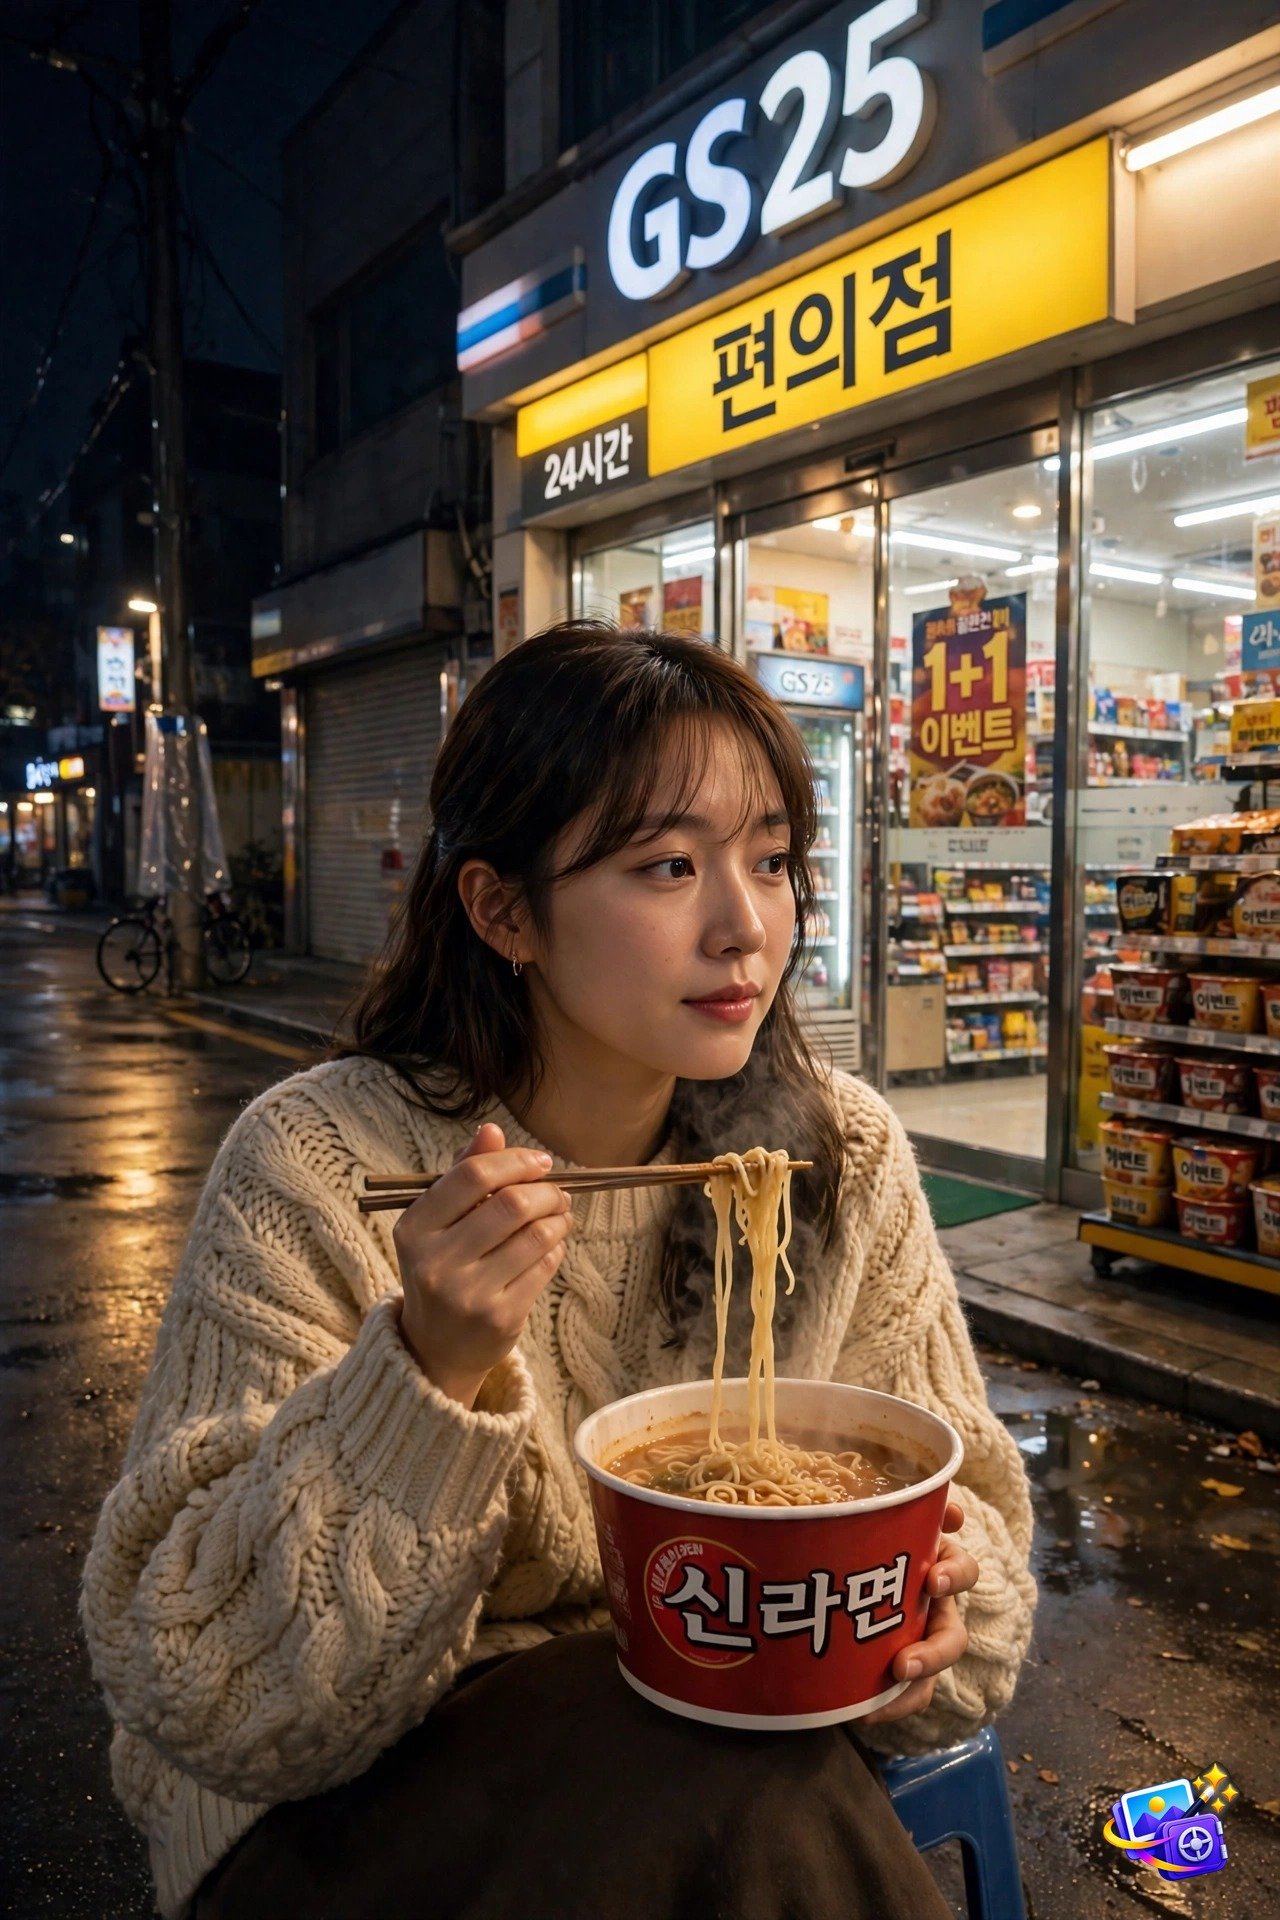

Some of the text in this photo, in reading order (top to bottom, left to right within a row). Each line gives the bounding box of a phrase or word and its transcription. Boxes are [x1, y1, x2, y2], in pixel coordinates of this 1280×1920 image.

[607, 0, 926, 300] GS25
[712, 229, 952, 432] 편의점
[543, 422, 633, 499] 24시간
[780, 670, 834, 696] GS25
[923, 631, 1009, 711] 1+1
[921, 707, 1015, 758] 이벤트
[663, 1553, 909, 1656] 신라면
